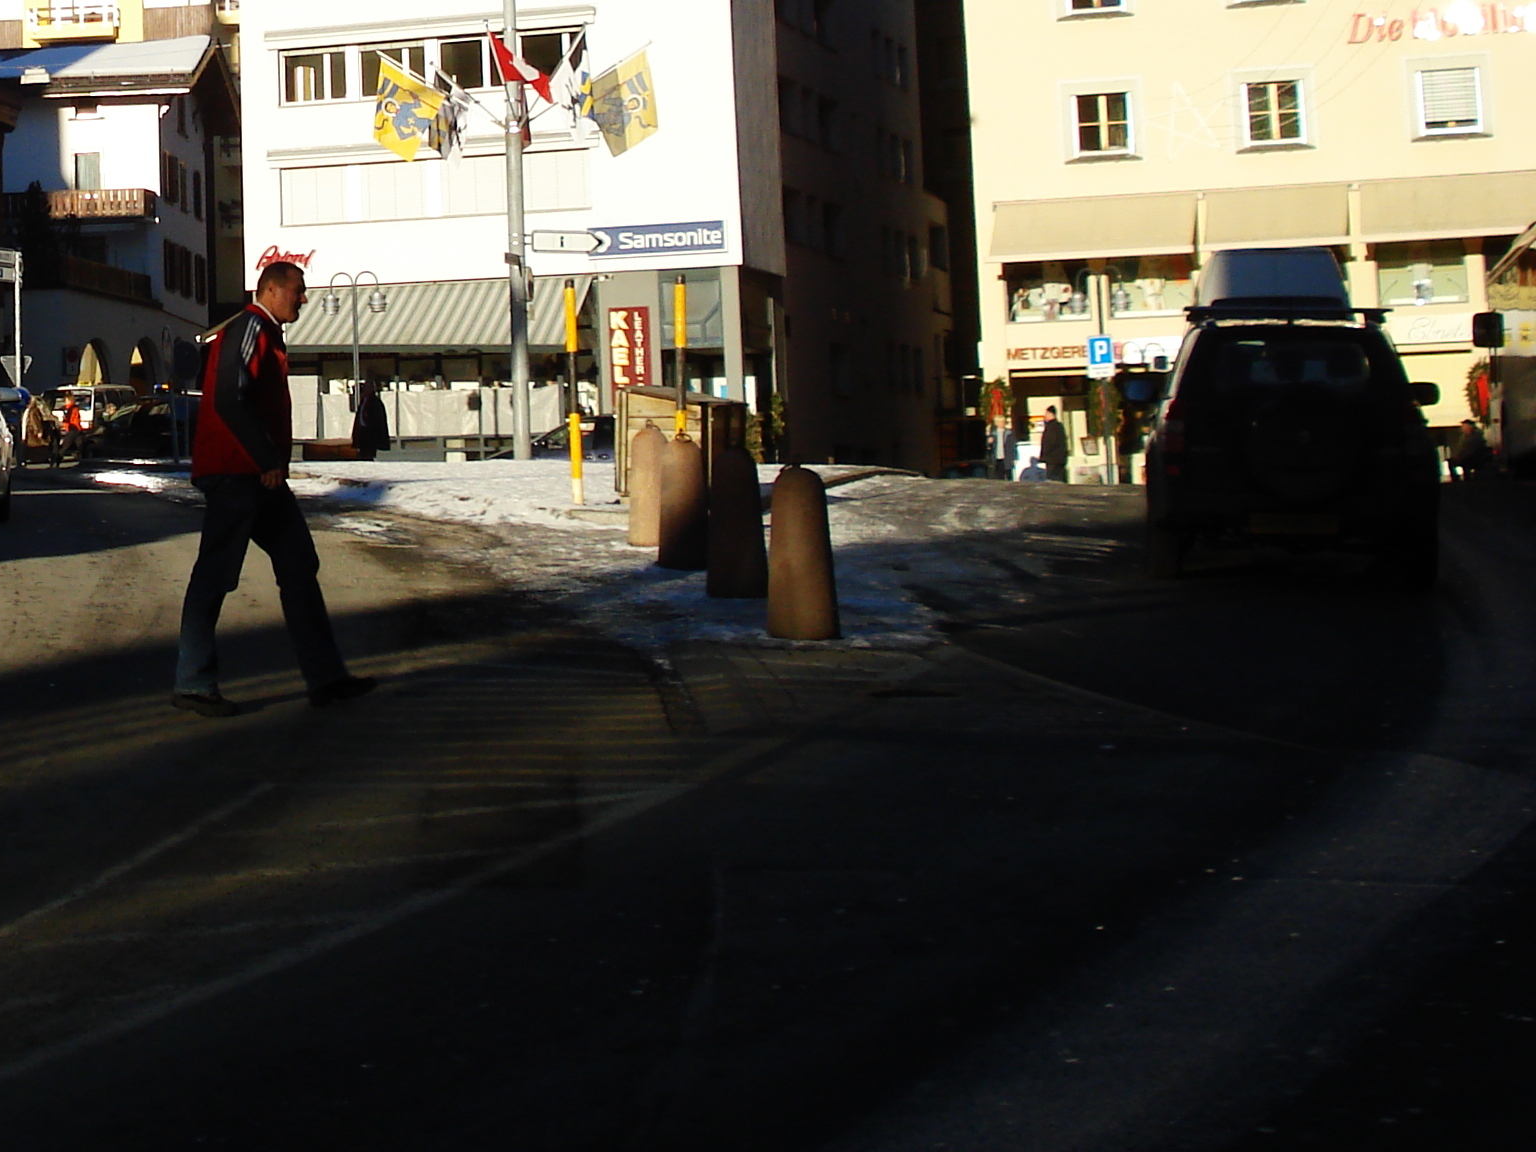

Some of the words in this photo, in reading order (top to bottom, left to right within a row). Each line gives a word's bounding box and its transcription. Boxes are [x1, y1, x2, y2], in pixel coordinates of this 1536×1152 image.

[1347, 11, 1404, 45] Die
[618, 227, 723, 250] Samsonite
[609, 310, 630, 387] KAEL
[633, 311, 645, 387] LEATHER-
[1006, 344, 1089, 361] METZGERE
[1094, 340, 1108, 363] P
